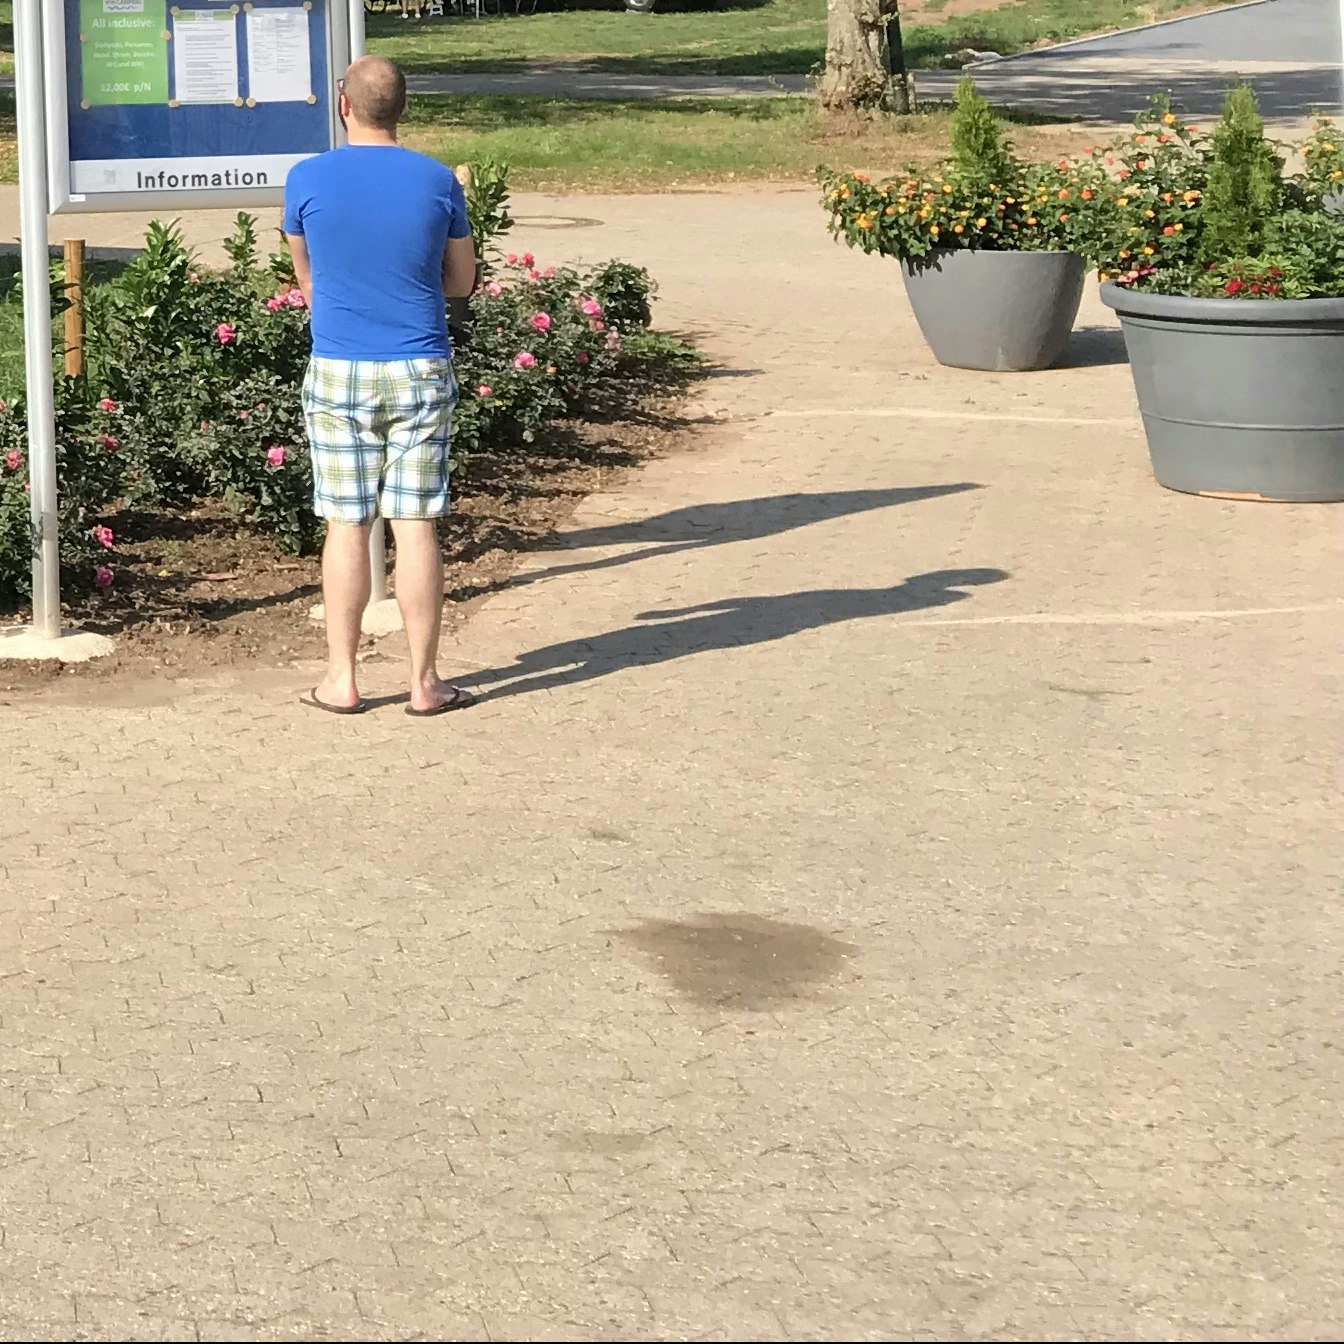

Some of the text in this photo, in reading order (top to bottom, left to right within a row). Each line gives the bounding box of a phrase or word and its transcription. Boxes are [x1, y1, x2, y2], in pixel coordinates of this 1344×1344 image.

[92, 17, 156, 28] All inclusive:
[134, 82, 152, 93] p/N
[137, 168, 268, 189] Information
